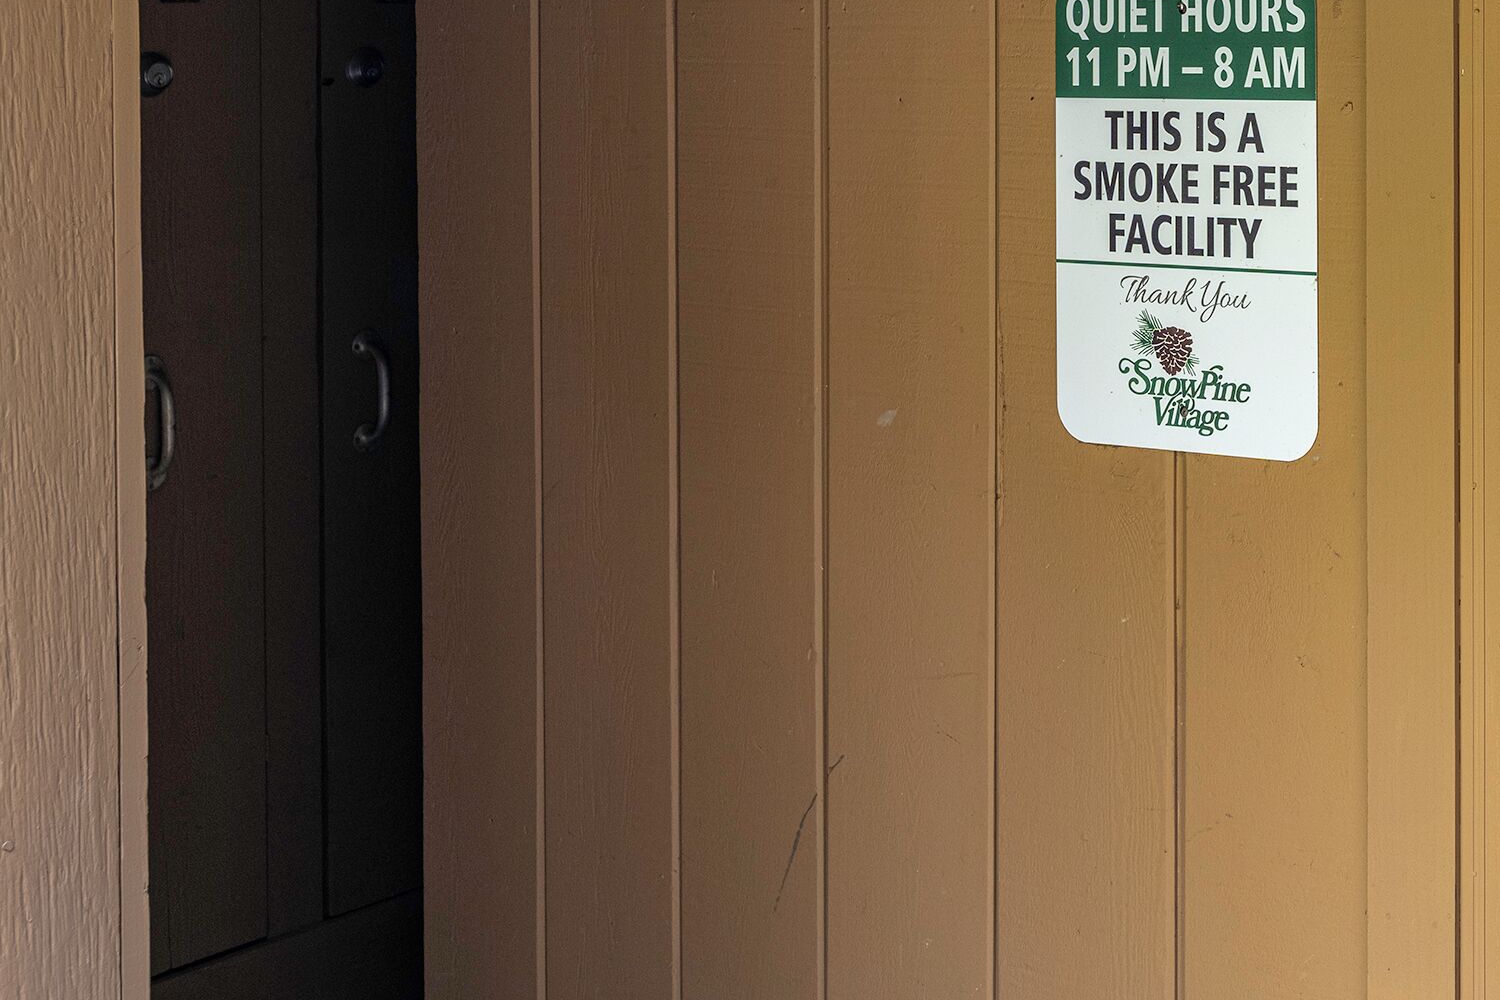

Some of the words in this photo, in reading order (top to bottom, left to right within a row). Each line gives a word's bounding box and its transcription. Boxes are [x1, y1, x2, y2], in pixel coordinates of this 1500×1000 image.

[1066, 46, 1100, 87] 11
[1117, 46, 1170, 87] PM
[1213, 45, 1235, 89] 8
[1244, 46, 1306, 89] AM
[1104, 110, 1182, 151] THIS
[1195, 111, 1227, 153] IS
[1237, 112, 1265, 153] A
[1073, 160, 1200, 205] SMOKE
[1212, 164, 1299, 208] FREE
[1108, 212, 1263, 260] FACILITY
[1120, 275, 1198, 313] Thank
[1199, 280, 1252, 323] You
[1152, 391, 1230, 437] Village
